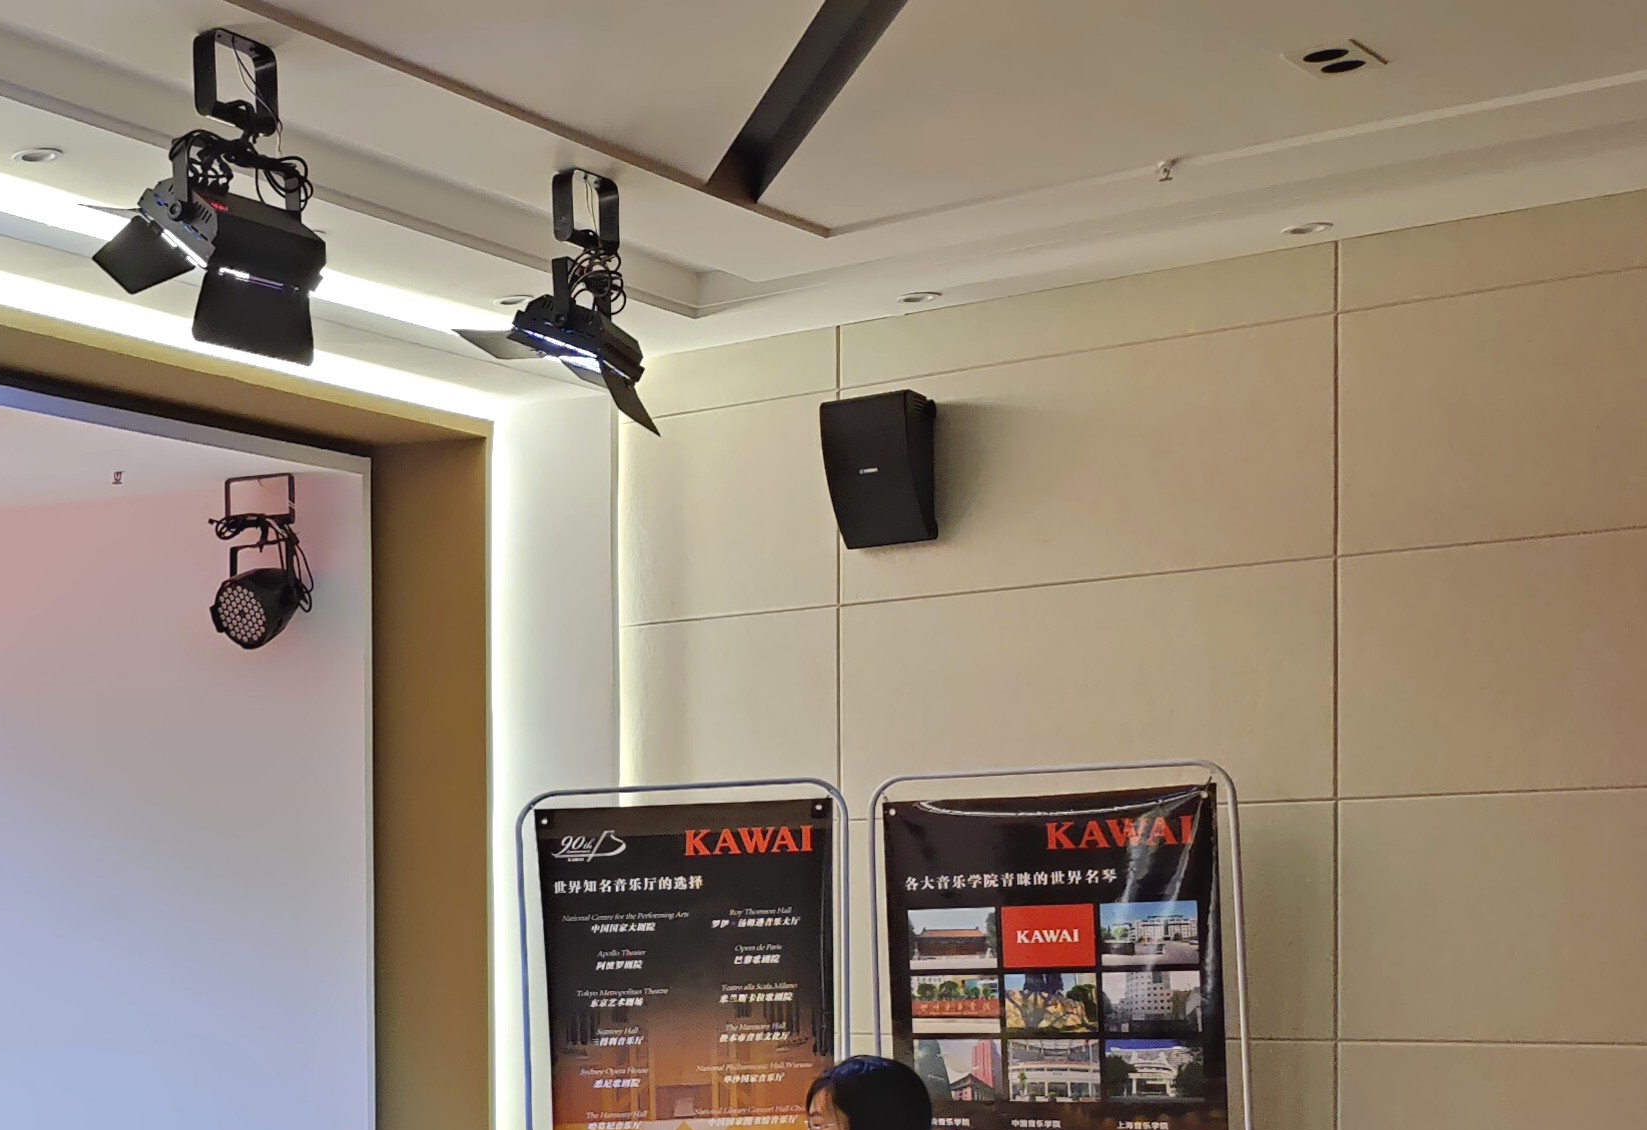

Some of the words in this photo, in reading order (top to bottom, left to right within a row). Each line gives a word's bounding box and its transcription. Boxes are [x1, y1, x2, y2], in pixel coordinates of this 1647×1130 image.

[684, 825, 813, 857] KAWAI
[1046, 815, 1195, 850] KAWAI
[554, 875, 703, 895] 世界知名音乐厅的选择
[905, 867, 1117, 891] 各大音乐学院青睐的世界名琴
[562, 914, 590, 922] National
[675, 911, 690, 919] Arts
[777, 906, 793, 915] Hall
[1016, 928, 1080, 943] KAWAI
